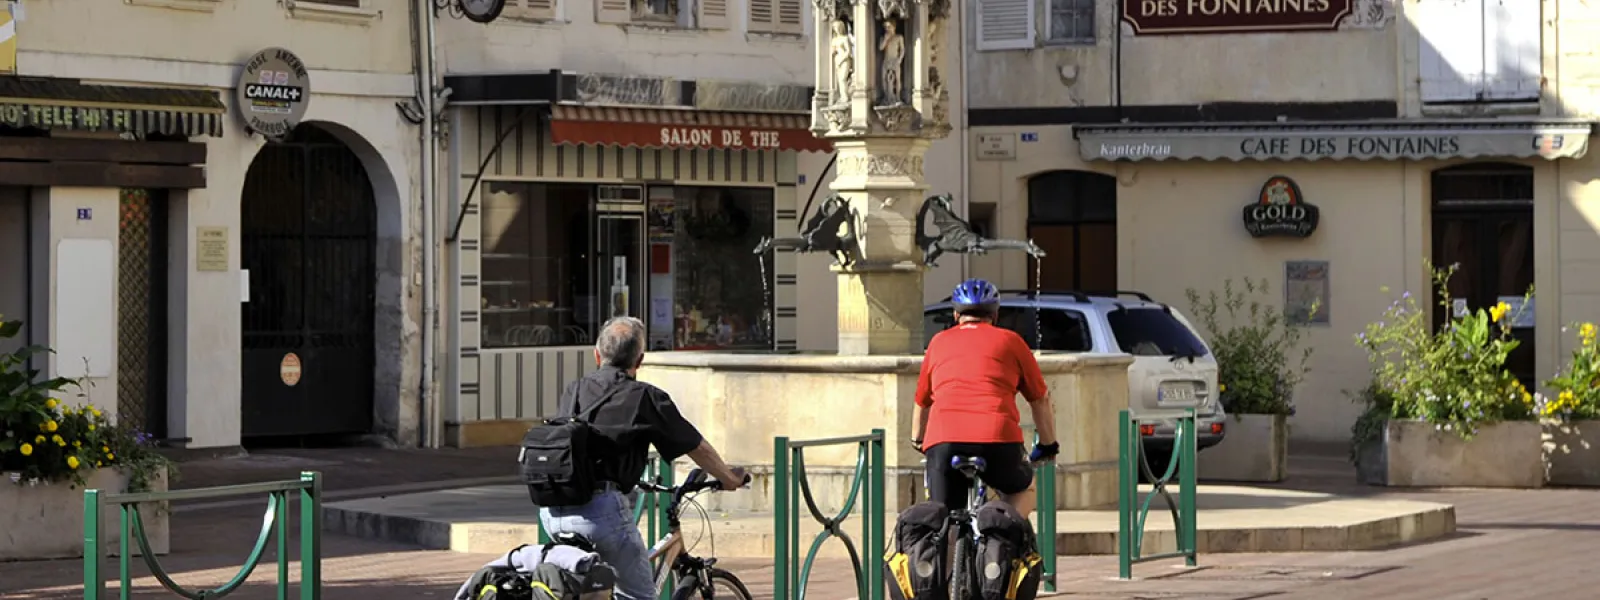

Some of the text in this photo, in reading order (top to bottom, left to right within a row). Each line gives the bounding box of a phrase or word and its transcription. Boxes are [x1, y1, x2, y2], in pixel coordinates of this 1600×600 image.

[1141, 0, 1330, 16] DES FONTAINES
[247, 52, 268, 75] POSE
[246, 85, 300, 100] CANAL+
[660, 126, 781, 147] SALON DE THE
[1240, 136, 1460, 155] CAFE DES FONTAINES
[1252, 205, 1306, 221] GOLD
